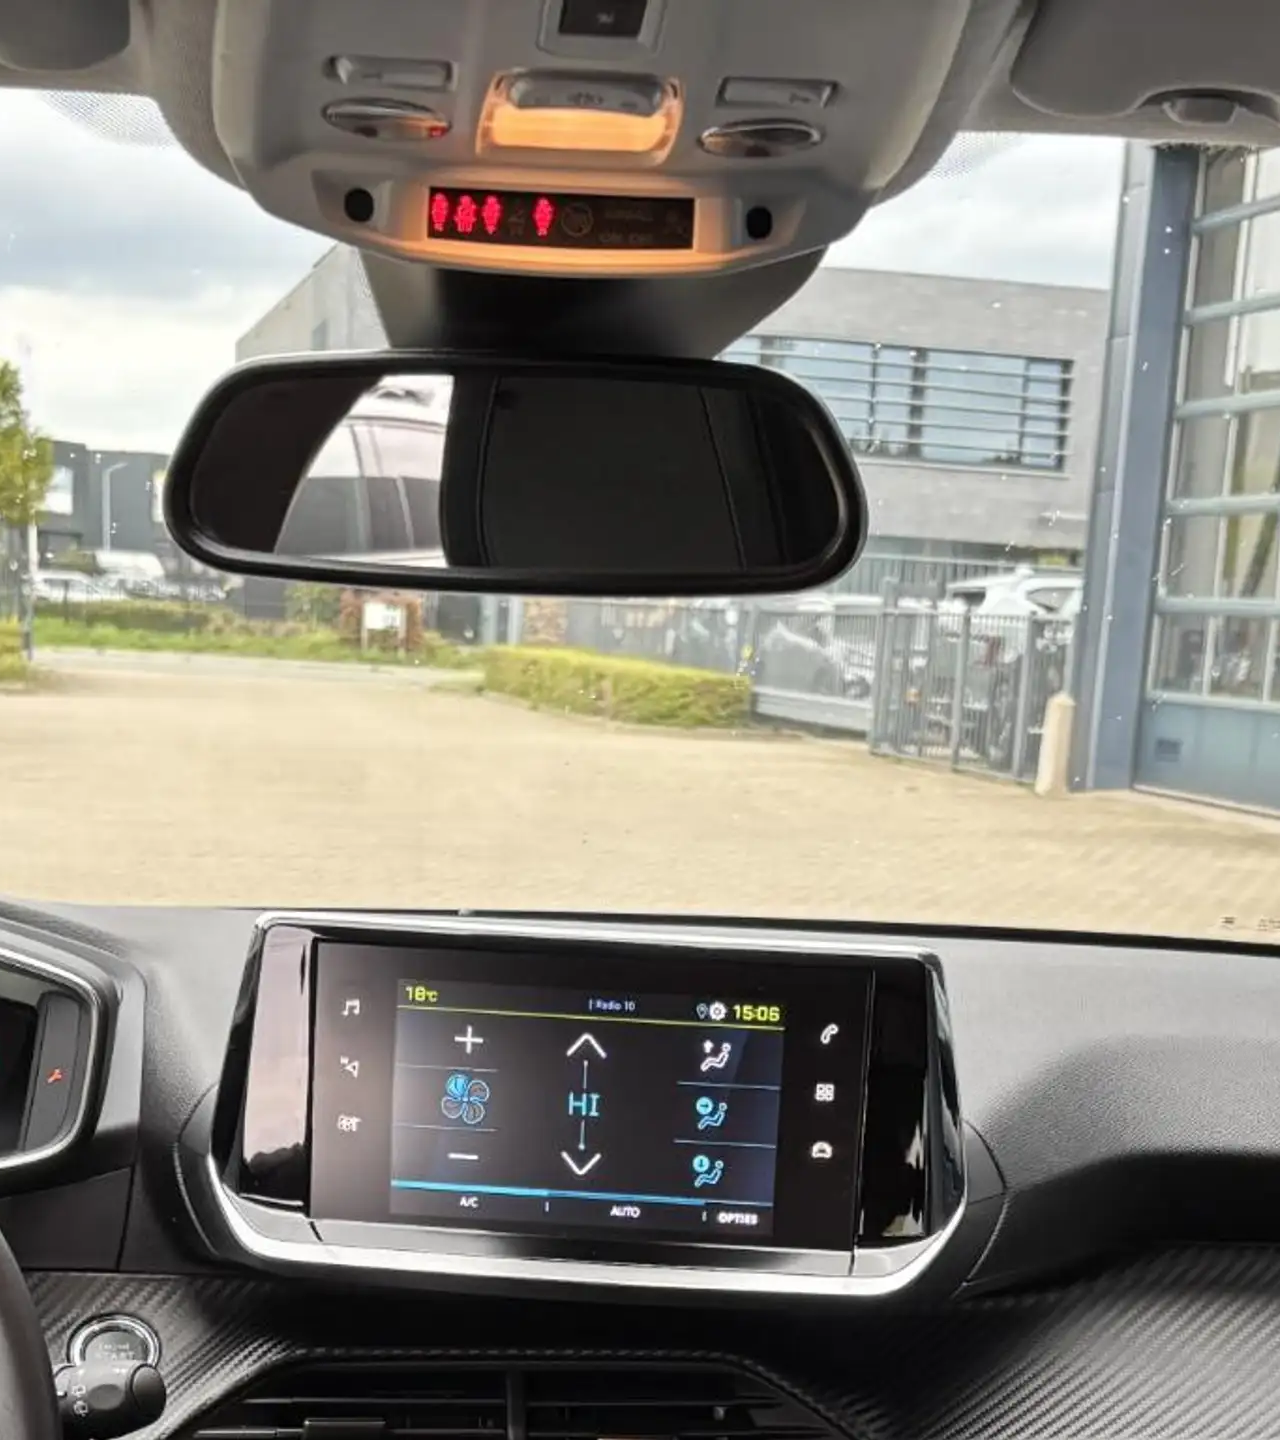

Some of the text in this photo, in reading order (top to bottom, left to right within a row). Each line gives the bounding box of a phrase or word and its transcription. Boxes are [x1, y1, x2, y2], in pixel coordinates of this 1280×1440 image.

[624, 1000, 636, 1012] 10
[568, 1091, 600, 1117] HI
[459, 1196, 479, 1209] A/C
[610, 1205, 641, 1219] AUTO
